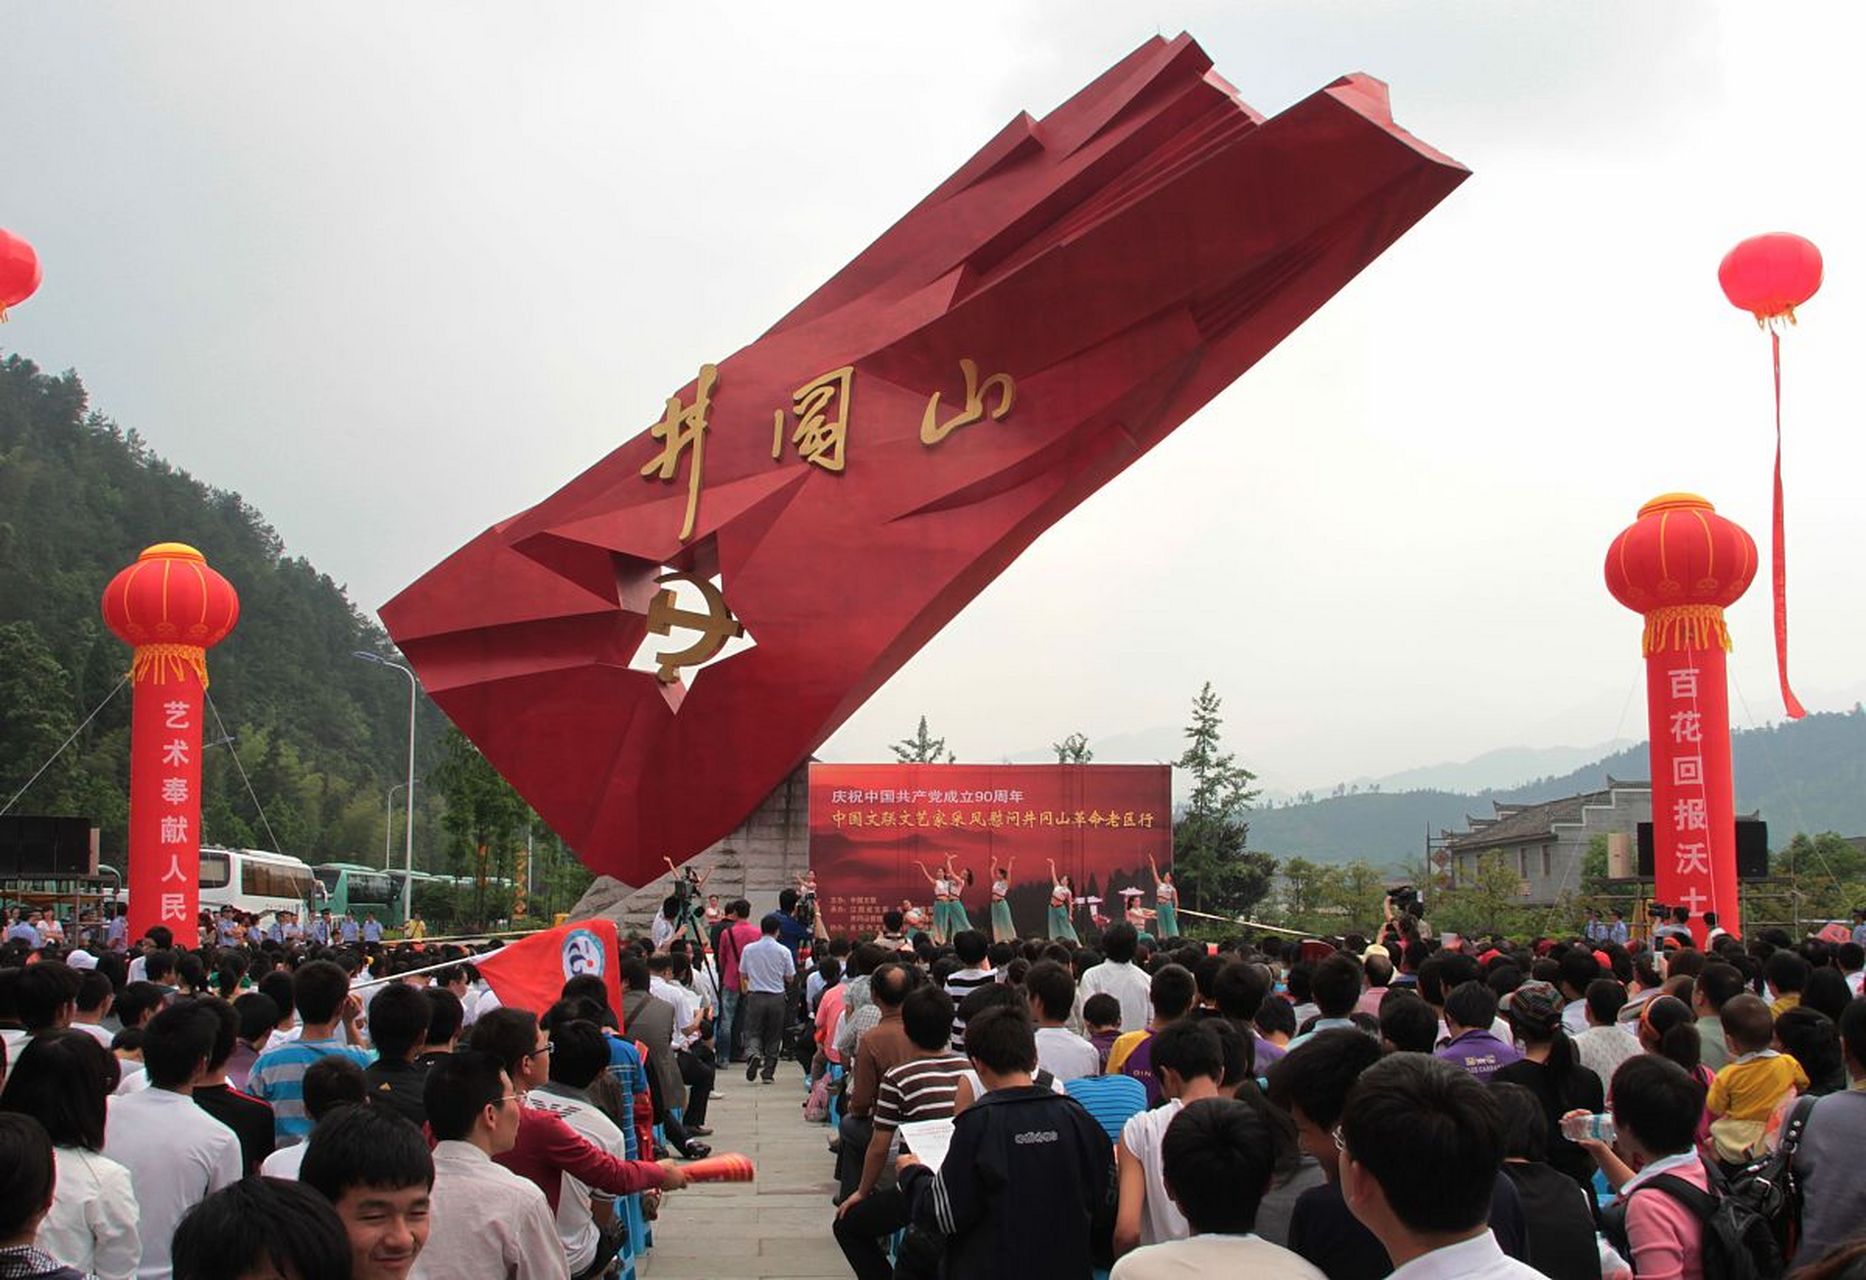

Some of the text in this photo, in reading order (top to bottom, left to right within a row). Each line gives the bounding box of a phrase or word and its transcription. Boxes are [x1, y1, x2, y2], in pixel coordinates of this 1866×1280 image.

[161, 701, 190, 922] 艺术奉献人民
[831, 789, 1025, 804] 庆祝中国共产党成立90周年
[832, 809, 1154, 829] 中国文联文艺家采风慰问井冈山革命老区行
[1668, 668, 1709, 918] 百花回报沃土
